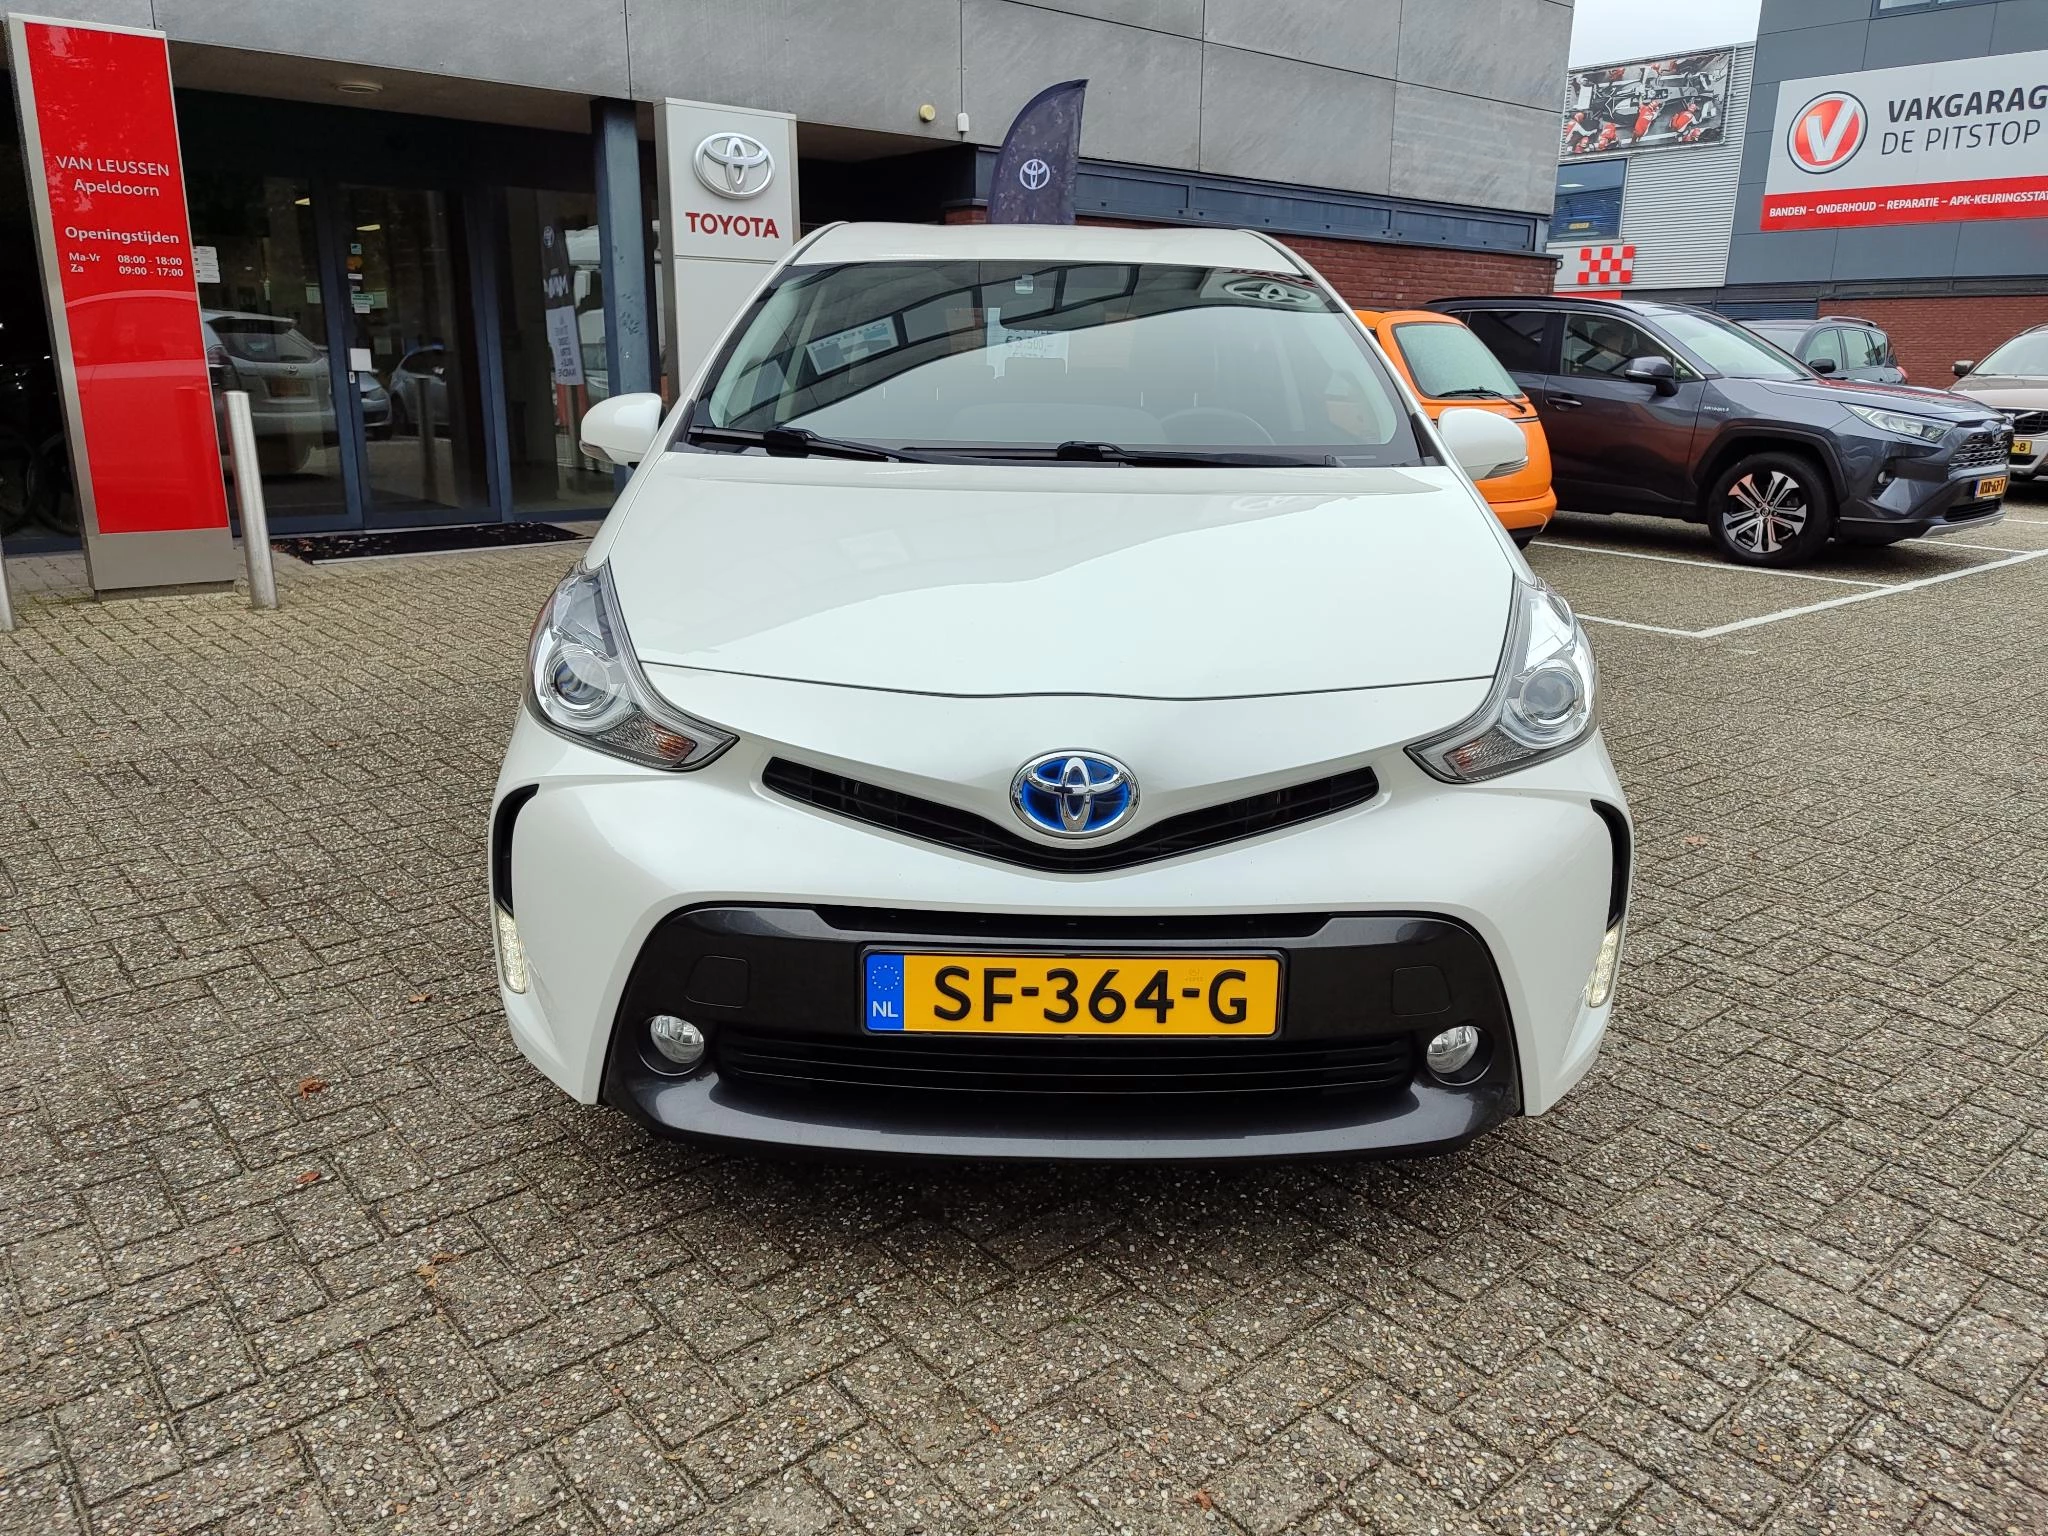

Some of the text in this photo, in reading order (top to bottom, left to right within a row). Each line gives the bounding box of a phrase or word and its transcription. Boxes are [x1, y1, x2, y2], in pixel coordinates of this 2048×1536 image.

[1880, 119, 2041, 156] DE PITSTOP
[56, 155, 169, 177] VAN LEUSSEN
[74, 178, 160, 197] Apeldoorn
[1769, 205, 1806, 217] BANDEN
[1816, 201, 1876, 213] ONDERHOUD
[1886, 197, 1939, 210] REPARATIE
[685, 212, 780, 239] TOYOTA
[65, 226, 180, 245] Openingstijden
[69, 252, 101, 263] Ma-Vr
[117, 254, 146, 264] 08:00
[155, 256, 182, 266] 18:00
[70, 263, 84, 274] Za
[118, 266, 147, 276] 09:00
[156, 267, 183, 278] 17:00
[933, 965, 1248, 1025] SF-364-G
[872, 1001, 898, 1018] NL
